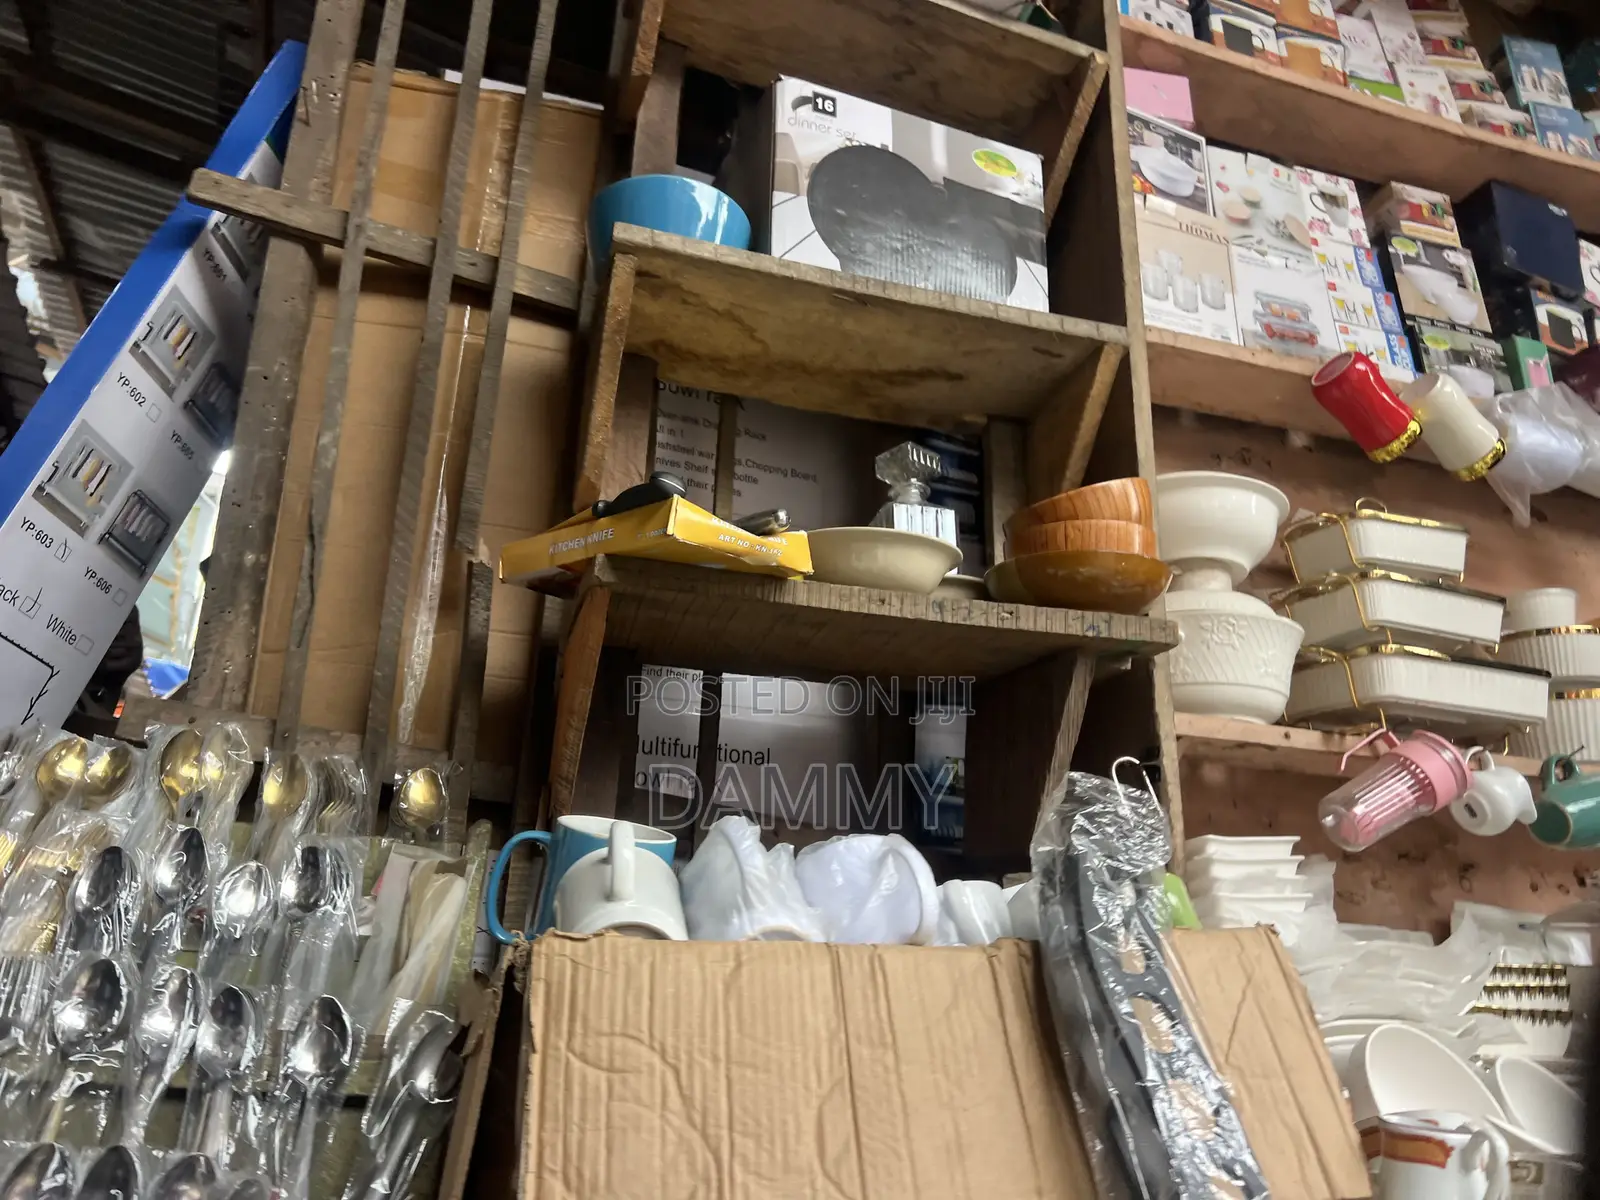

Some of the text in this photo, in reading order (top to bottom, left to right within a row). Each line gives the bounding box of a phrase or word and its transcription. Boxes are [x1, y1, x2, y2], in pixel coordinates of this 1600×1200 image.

[815, 96, 835, 113] 16
[787, 112, 833, 135] dinner
[116, 371, 147, 408] YP:602
[655, 457, 681, 469] nives
[20, 516, 54, 549] YP:603
[548, 537, 586, 556] KITCHEN
[586, 527, 615, 545] KNIFE
[718, 533, 736, 545] ART
[83, 566, 113, 595] YP:606
[46, 613, 77, 646] White
